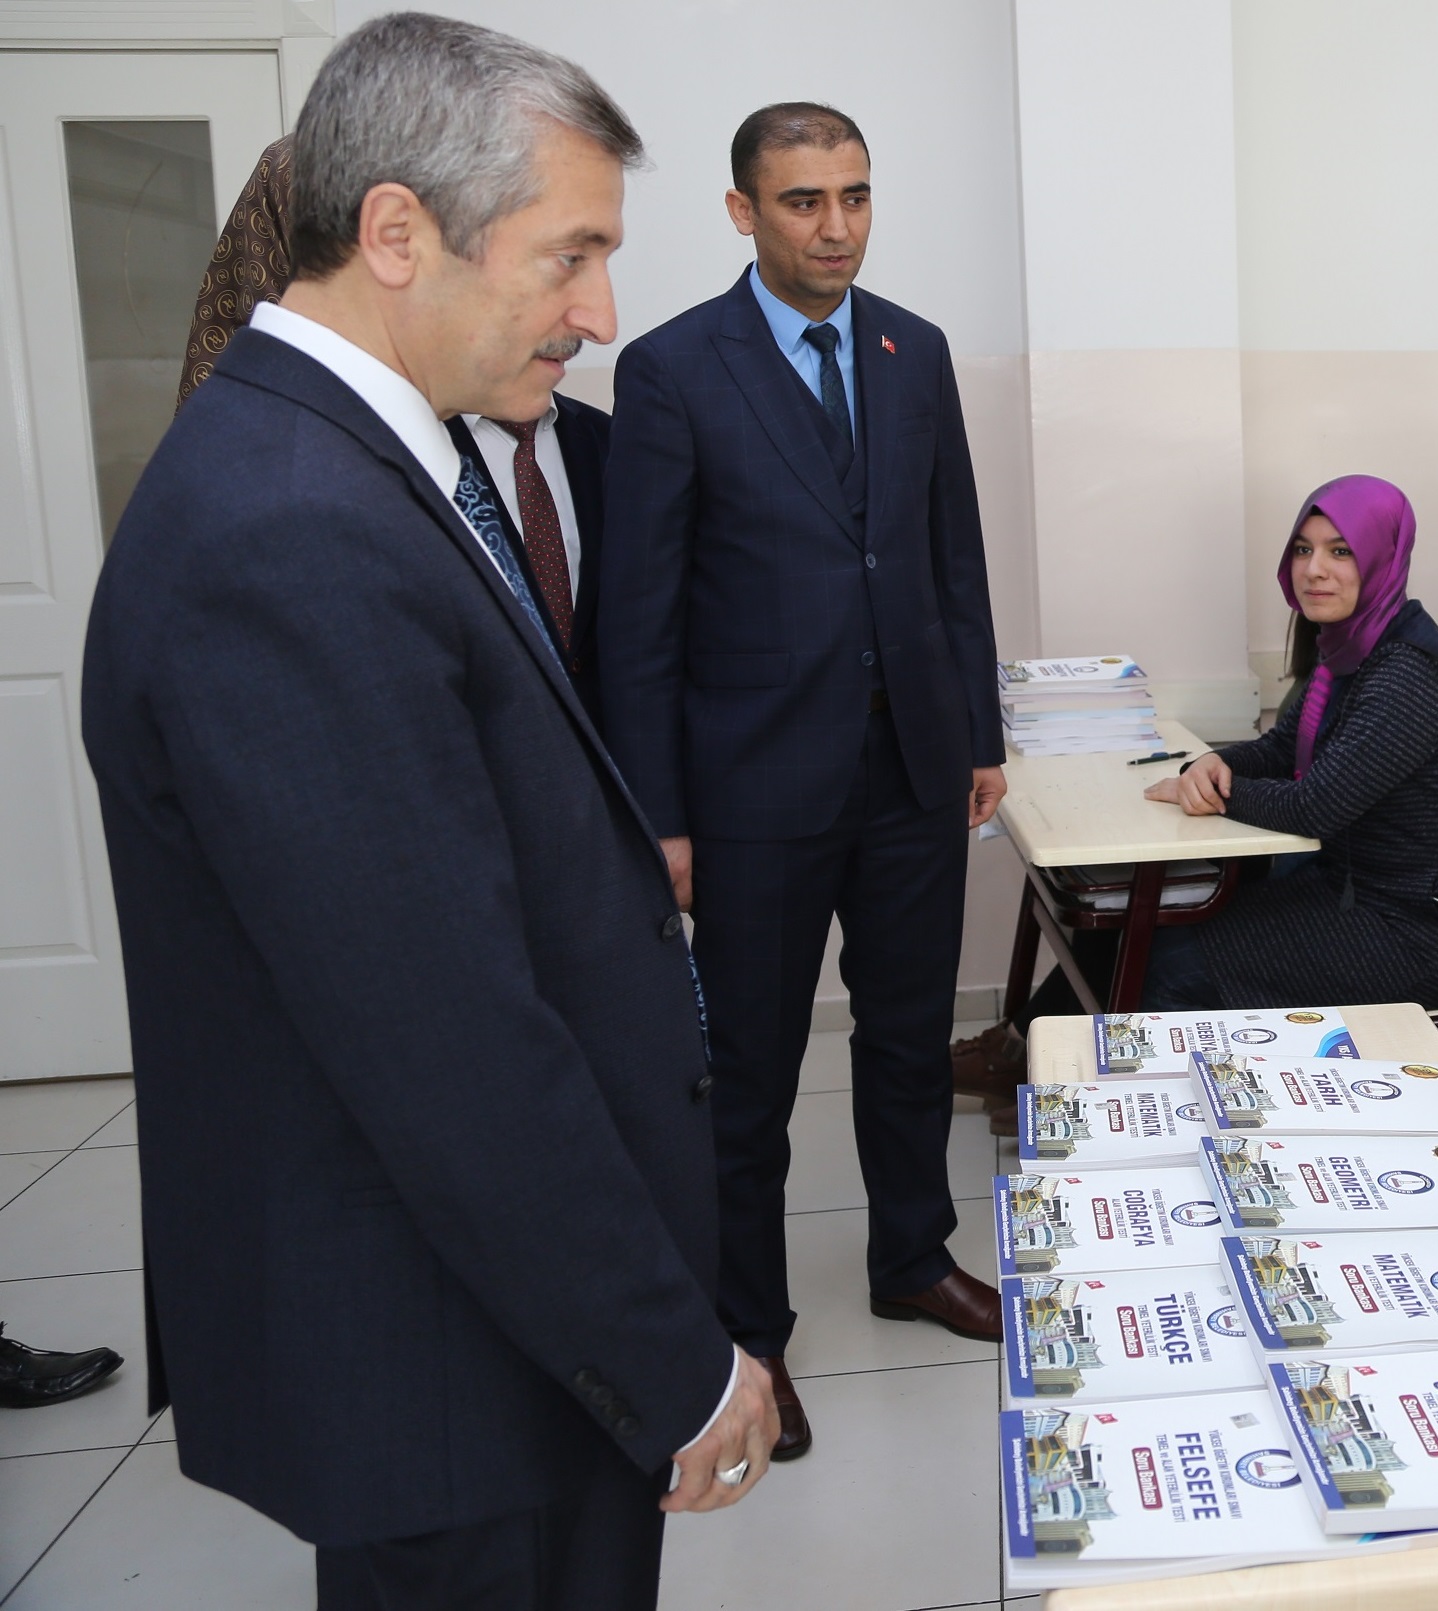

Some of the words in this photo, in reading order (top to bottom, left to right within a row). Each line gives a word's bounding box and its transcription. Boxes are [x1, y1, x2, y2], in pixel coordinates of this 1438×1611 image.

[1196, 1022, 1219, 1053] EDEBİYA
[1311, 1073, 1343, 1106] TARİH
[1137, 1093, 1165, 1137] MATEMATİK
[1329, 1156, 1377, 1210] GEOMETRİ
[1094, 1200, 1106, 1214] Soru
[1096, 1214, 1109, 1237] Bankası
[1124, 1190, 1155, 1247] COĞRAFYA
[1343, 1268, 1359, 1284] Soru
[1352, 1284, 1373, 1310] Bankası
[1374, 1254, 1430, 1318] MATEMATİK
[1120, 1309, 1133, 1326] Soru
[1155, 1294, 1192, 1364] TÜRKÇE
[1123, 1326, 1138, 1354] Bankası
[1403, 1399, 1421, 1418] Soru
[1413, 1419, 1438, 1452] Bankası
[1135, 1451, 1150, 1471] Soru
[1176, 1433, 1220, 1519] FELSEFE
[1139, 1471, 1156, 1505] Bankası
